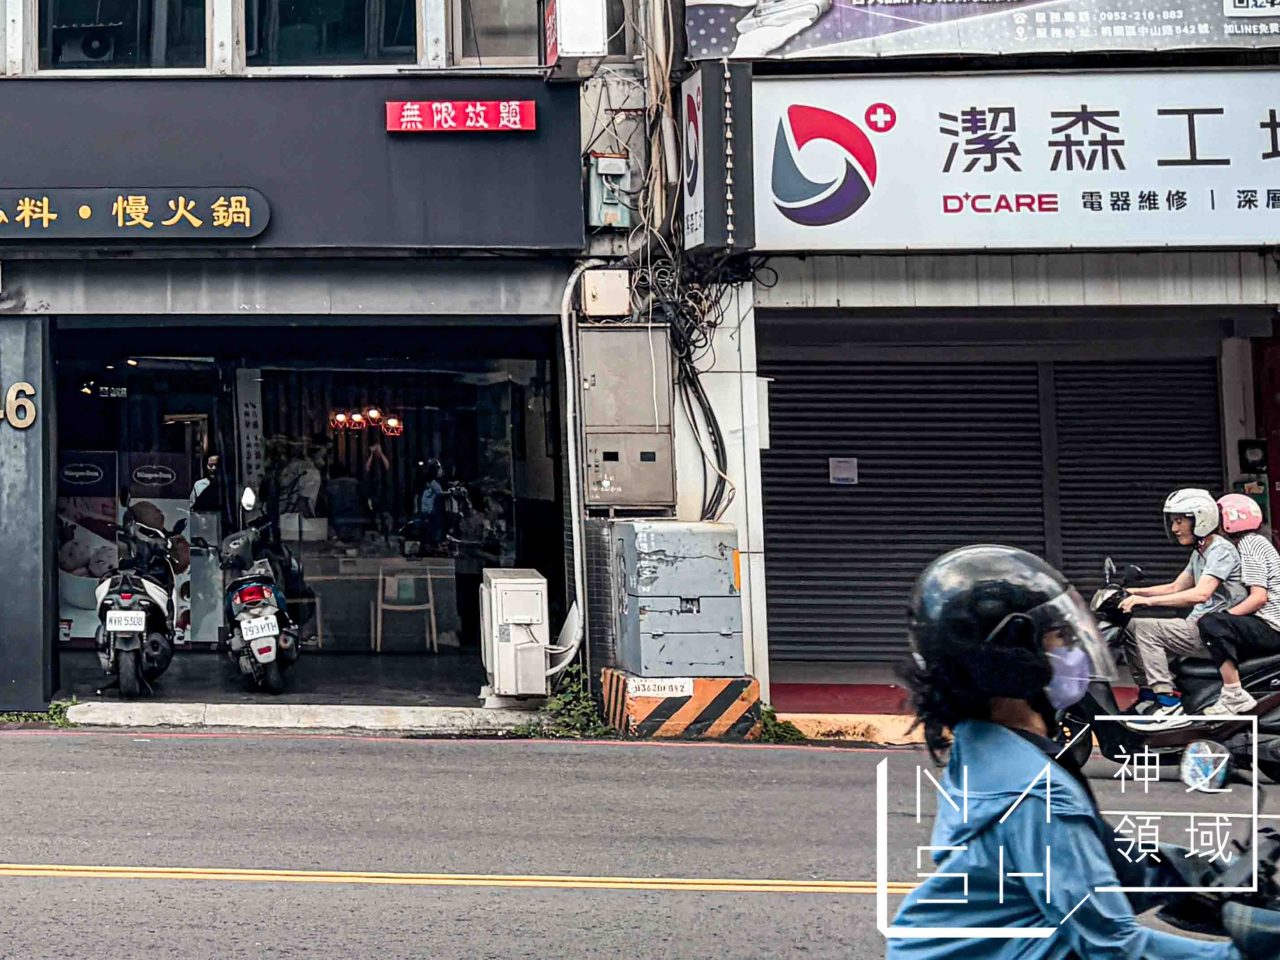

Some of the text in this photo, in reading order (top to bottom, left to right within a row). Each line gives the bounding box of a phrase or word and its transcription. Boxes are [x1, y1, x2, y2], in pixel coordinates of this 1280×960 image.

[400, 102, 523, 129] 無限放題
[938, 104, 1280, 175] 潔森工
[1081, 189, 1188, 212] 電器維修
